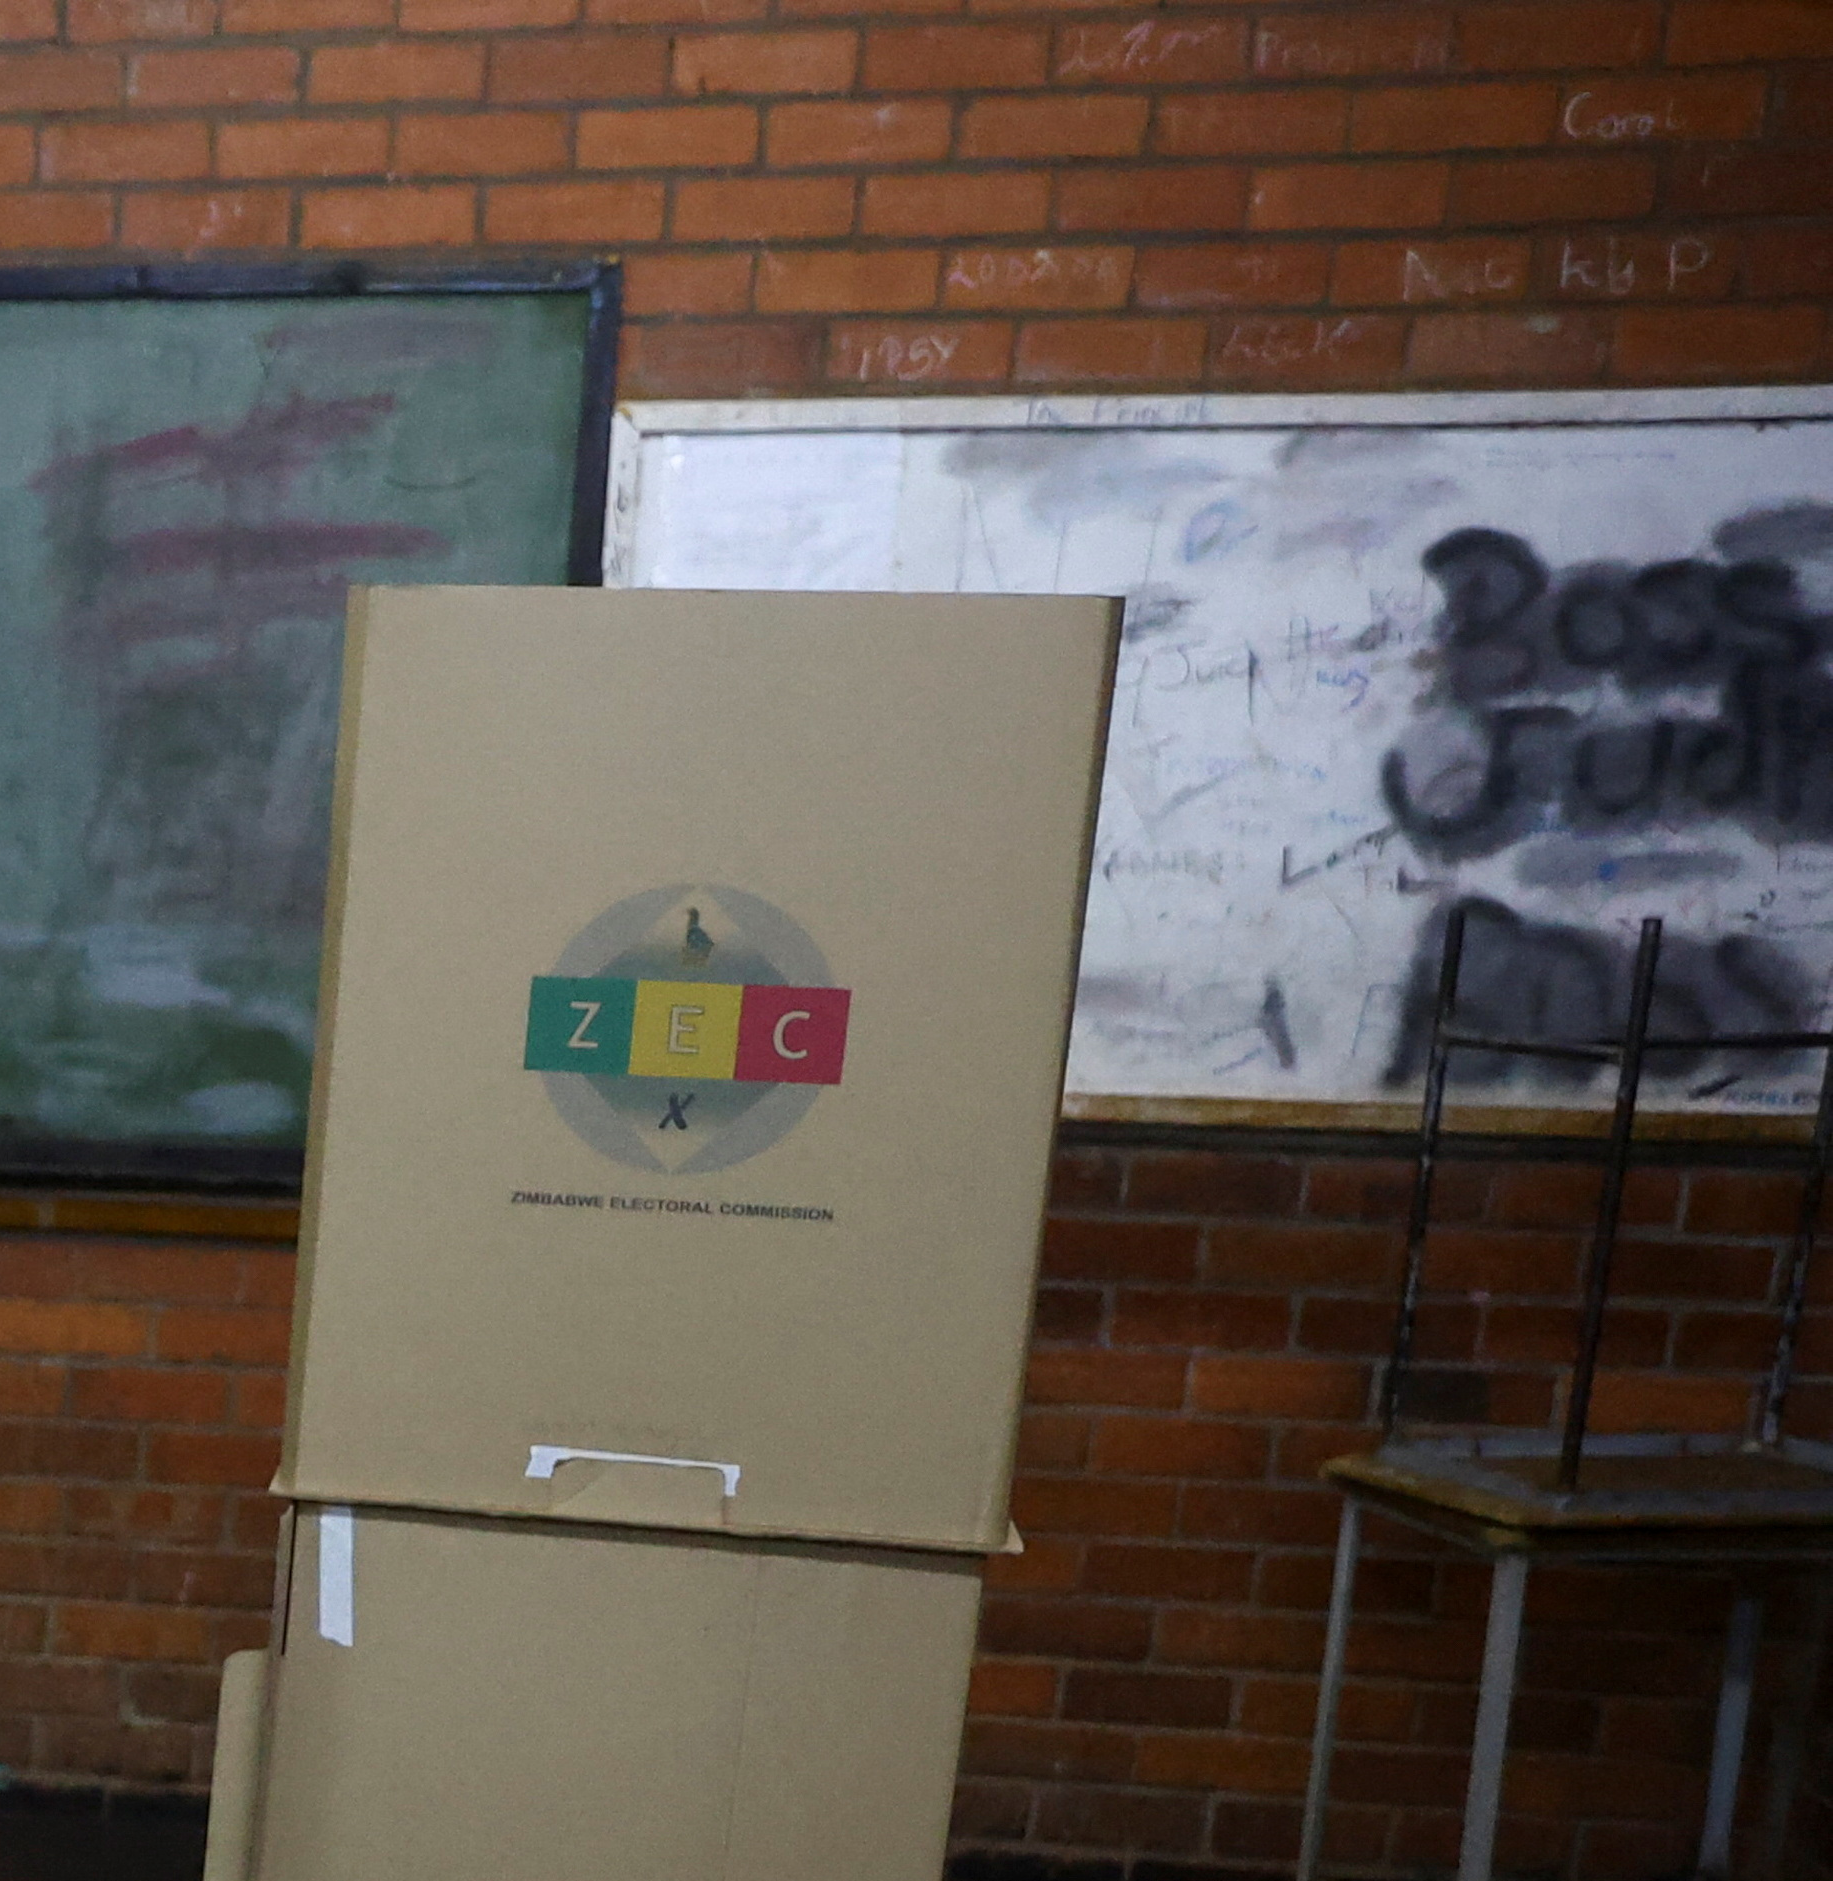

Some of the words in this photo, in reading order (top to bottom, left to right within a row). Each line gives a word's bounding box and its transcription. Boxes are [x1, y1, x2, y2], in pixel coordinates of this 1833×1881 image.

[511, 1190, 604, 1208] ZIMBABWE
[609, 1196, 714, 1214] ELECTORAL
[719, 1202, 834, 1221] COMMISSION
